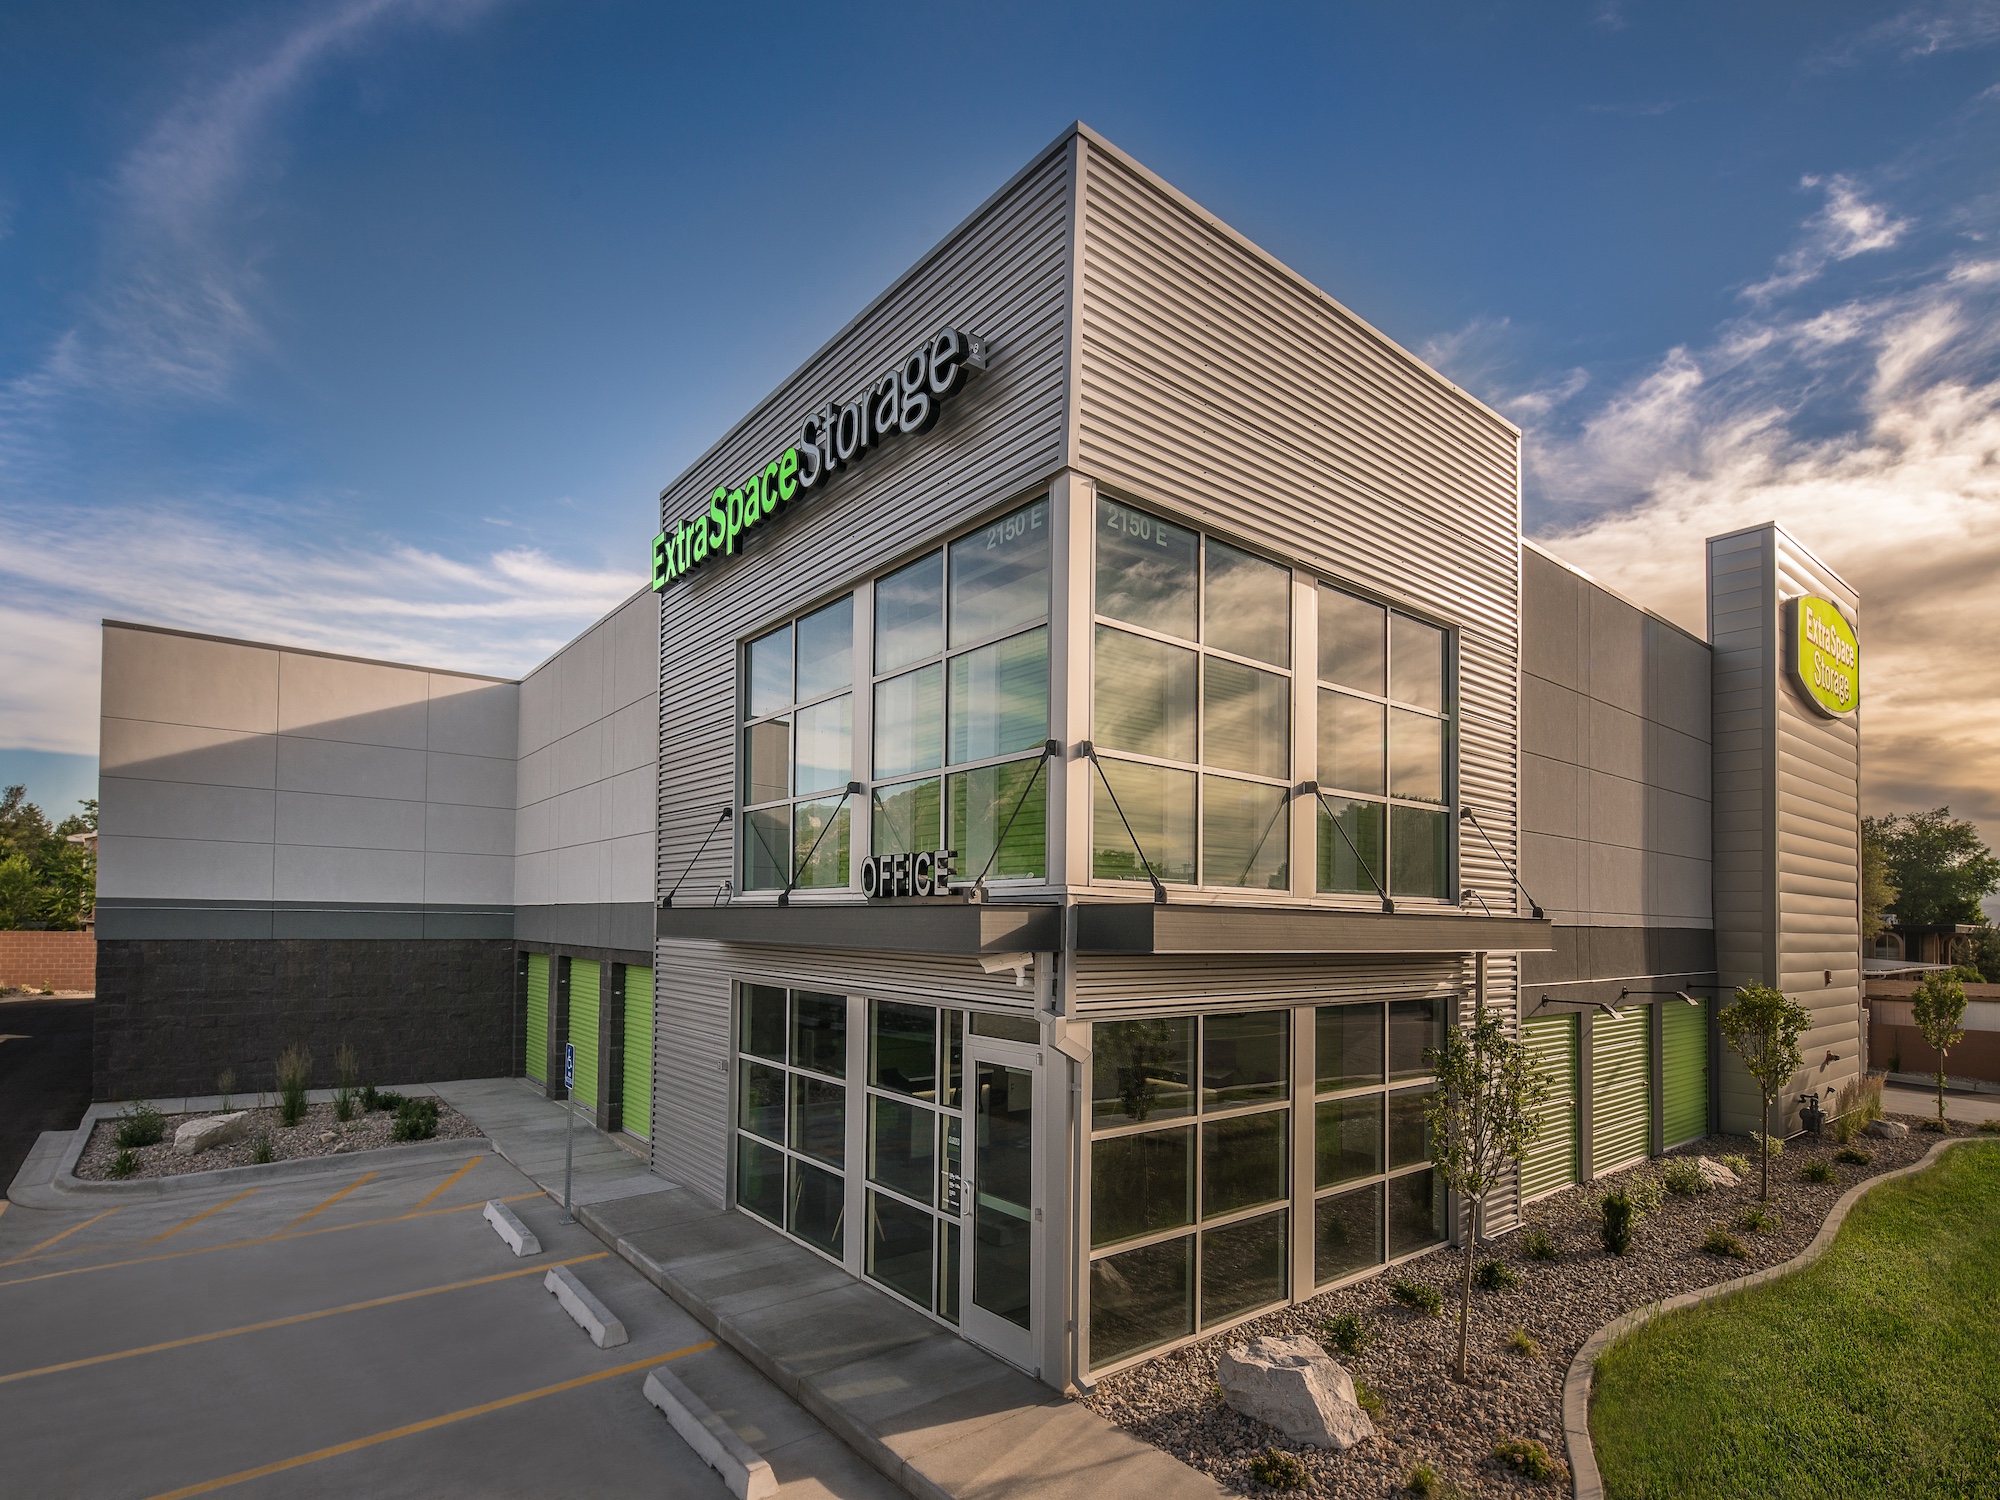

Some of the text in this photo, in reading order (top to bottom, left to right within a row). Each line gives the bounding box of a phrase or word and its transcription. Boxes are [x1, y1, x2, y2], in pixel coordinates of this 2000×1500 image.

[986, 505, 1042, 550] 2150 E
[1107, 505, 1168, 547] 2150 E
[1814, 650, 1850, 706] Storage
[861, 850, 950, 899] OFFICE
